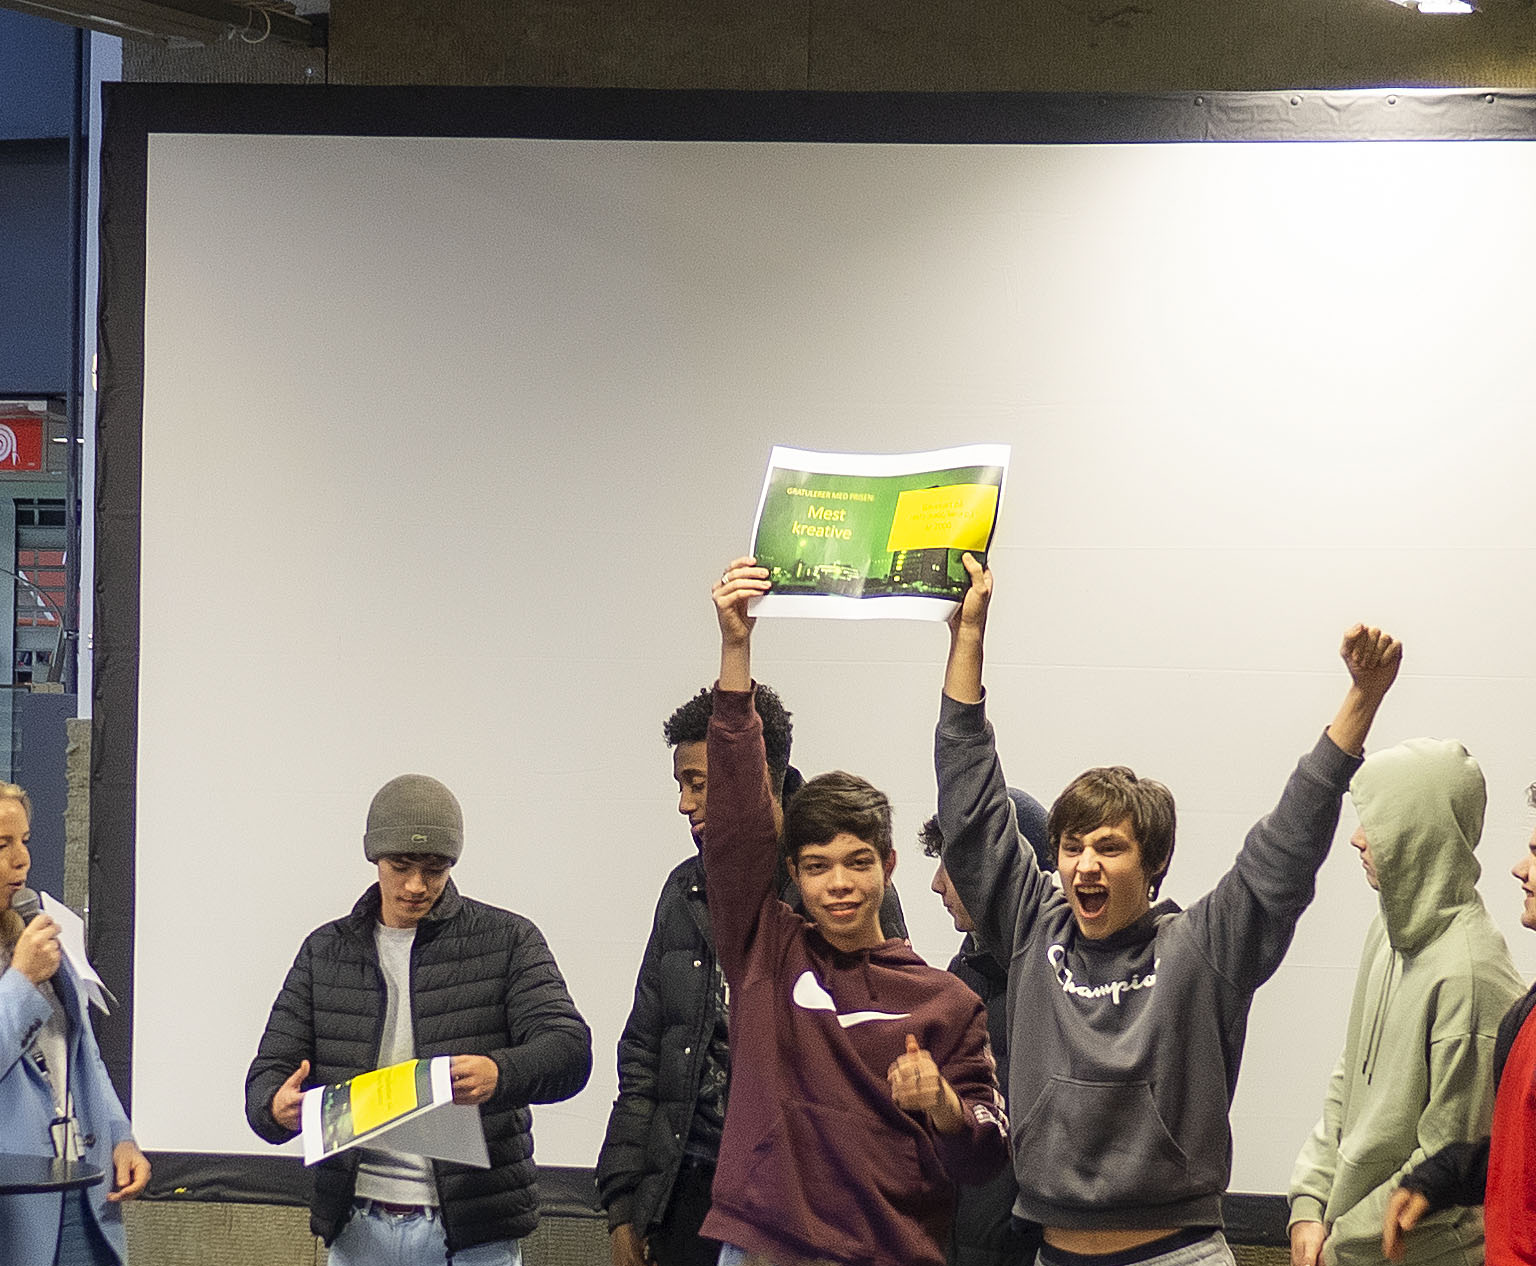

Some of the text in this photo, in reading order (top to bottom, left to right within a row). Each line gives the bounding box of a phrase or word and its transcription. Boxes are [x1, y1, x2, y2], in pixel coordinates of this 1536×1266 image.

[831, 492, 849, 501] MED
[807, 505, 846, 522] Mest
[791, 520, 852, 541] kreative
[1047, 944, 1160, 1004] Champio
